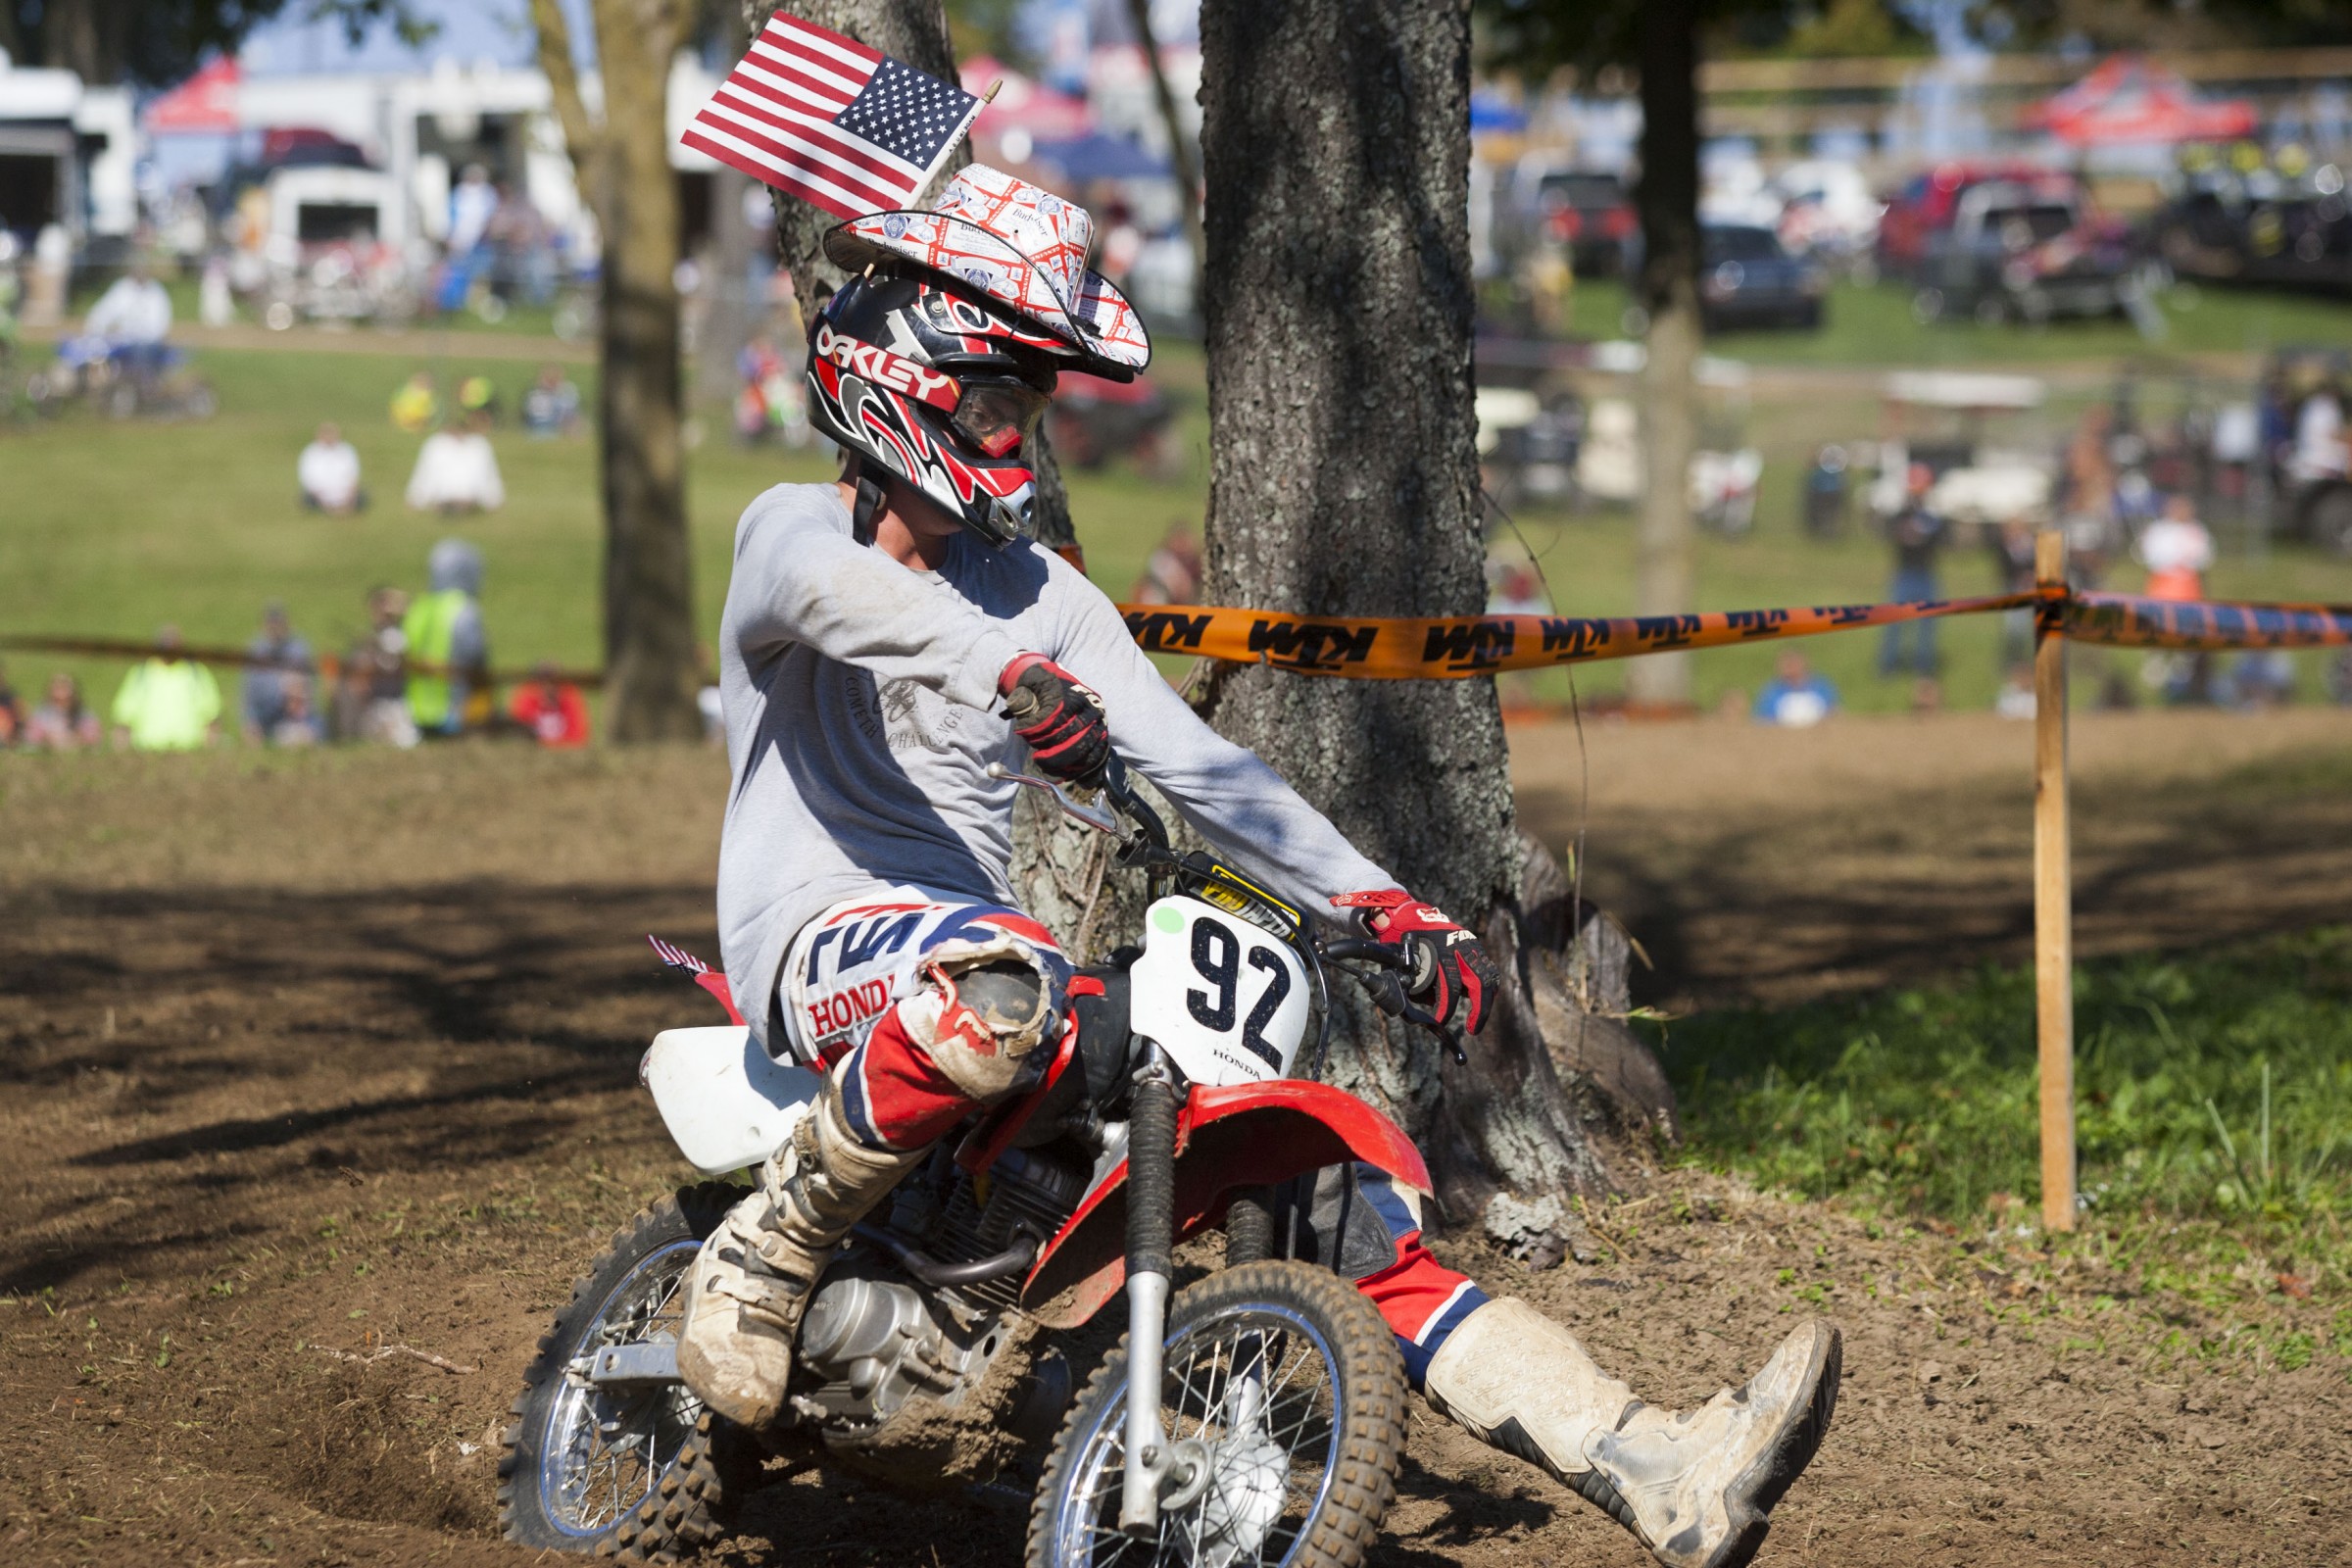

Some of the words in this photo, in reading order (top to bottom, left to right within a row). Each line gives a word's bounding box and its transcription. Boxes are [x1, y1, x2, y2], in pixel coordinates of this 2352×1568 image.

[938, 218, 950, 246] GENUIN
[816, 322, 951, 401] OAKLEY
[1248, 618, 1380, 671] KTM
[1422, 619, 1515, 671] KTM
[1540, 617, 1611, 661] KTM
[887, 708, 963, 749] CHALLENGE
[808, 971, 896, 1038] HOND
[1186, 916, 1292, 1076] 92
[1212, 1048, 1262, 1082] HONDA
